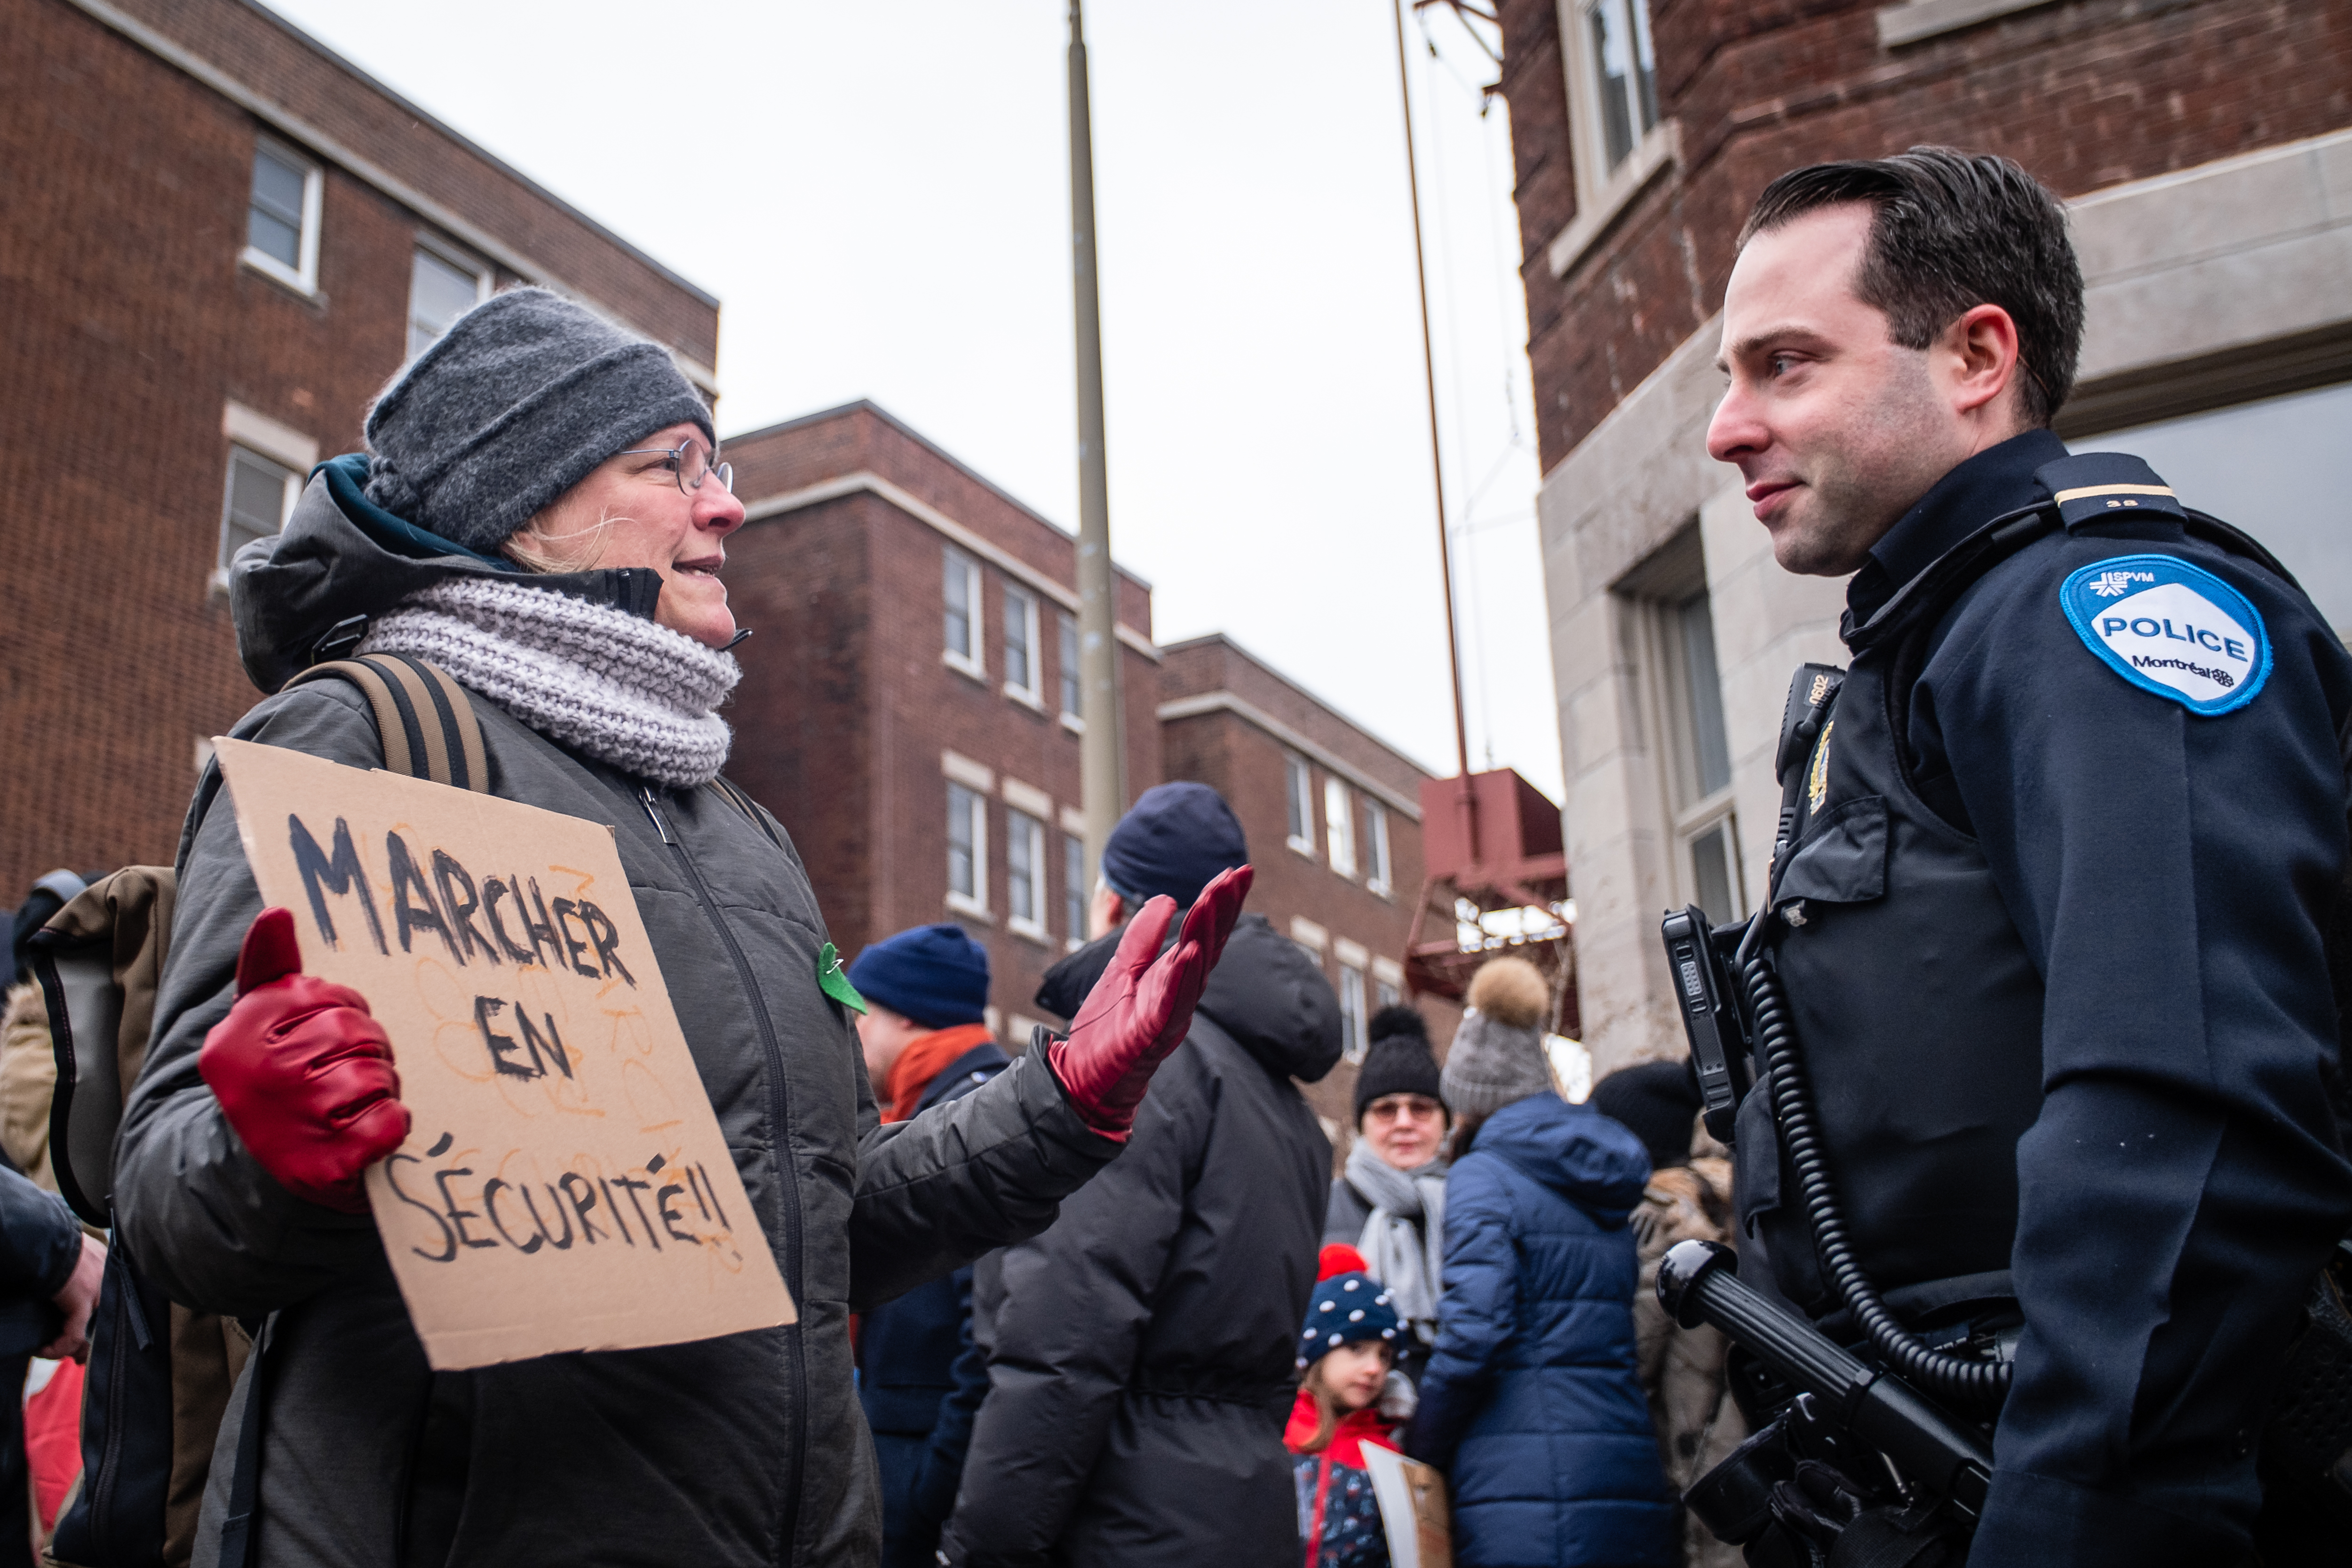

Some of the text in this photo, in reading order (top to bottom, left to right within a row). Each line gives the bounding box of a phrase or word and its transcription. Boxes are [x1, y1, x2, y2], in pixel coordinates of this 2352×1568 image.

[2113, 571, 2154, 582] SPVM
[2103, 617, 2249, 662] POLICE
[2131, 655, 2211, 679] Montréal
[1809, 674, 1829, 705] 0602
[287, 812, 638, 991] MARCHER
[474, 995, 574, 1082] EN
